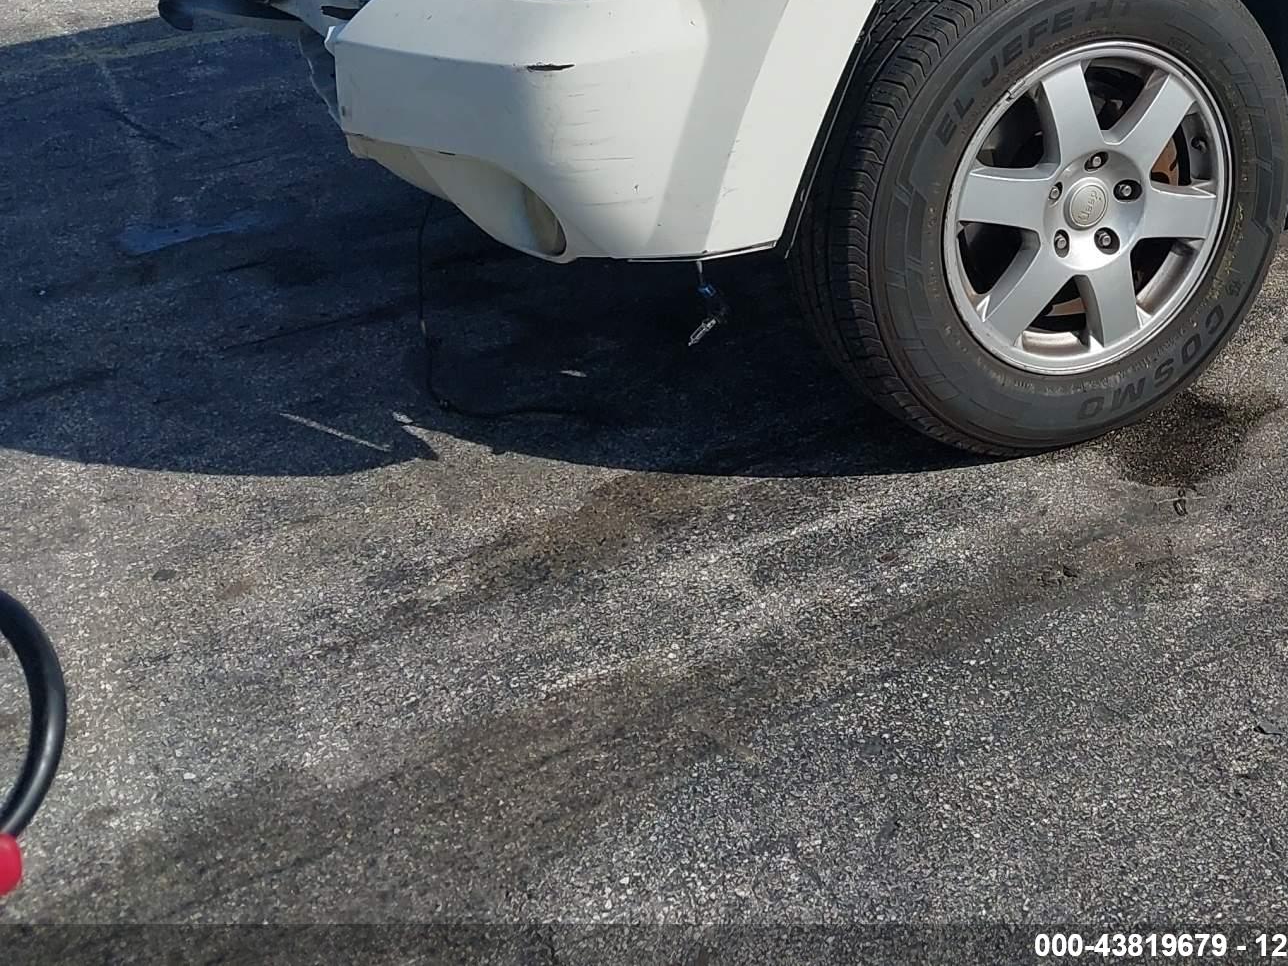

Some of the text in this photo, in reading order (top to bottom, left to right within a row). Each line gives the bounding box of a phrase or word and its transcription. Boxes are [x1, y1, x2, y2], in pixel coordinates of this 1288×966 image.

[935, 97, 976, 147] EL
[980, 6, 1076, 88] JEFE
[1077, 303, 1225, 420] COSMO
